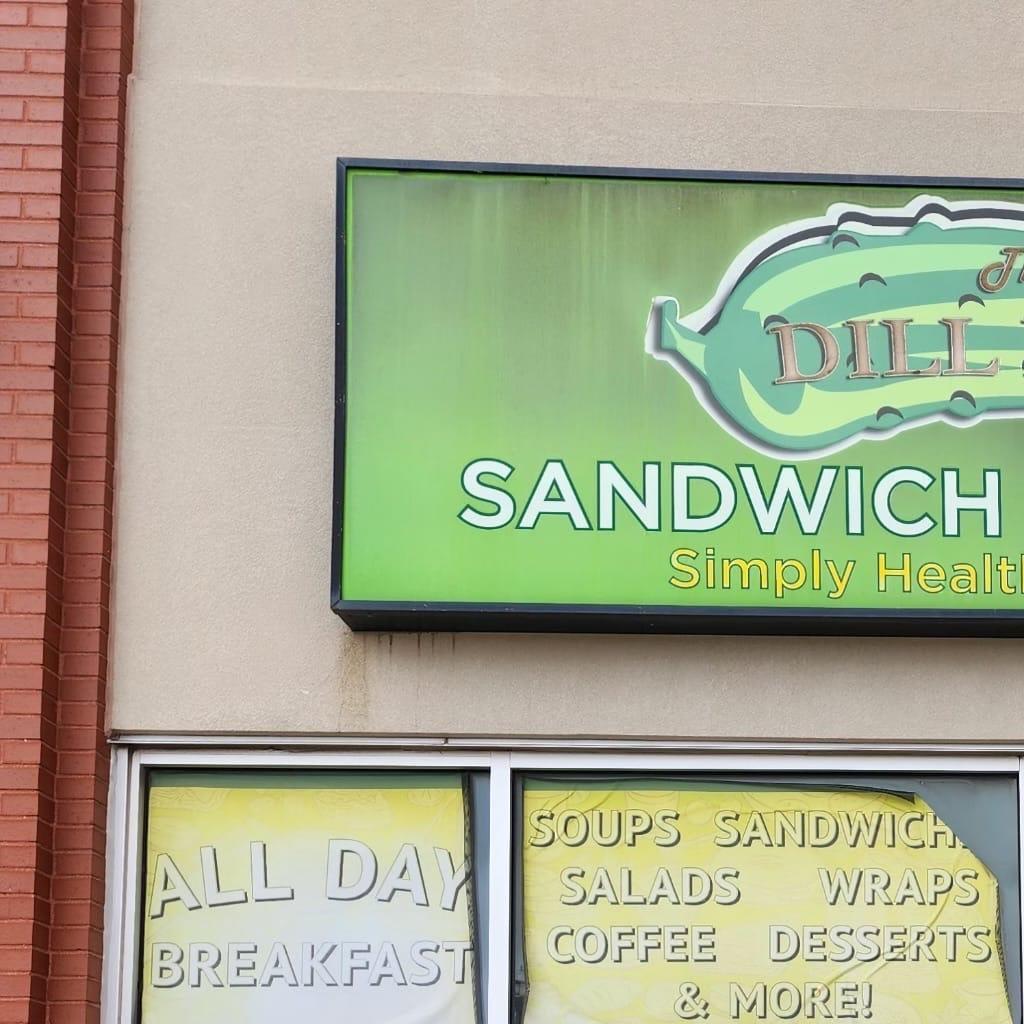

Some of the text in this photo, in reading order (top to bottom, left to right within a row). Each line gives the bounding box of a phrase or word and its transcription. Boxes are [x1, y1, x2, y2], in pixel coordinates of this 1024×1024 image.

[766, 315, 1001, 385] DILL
[458, 457, 1002, 538] SANDWICH
[668, 547, 856, 599] Simply
[528, 808, 968, 849] SOUPS SANDWICH
[148, 838, 472, 919] ALL DAY
[559, 866, 980, 907] SALADS WRAPS
[151, 940, 475, 988] BREAKFAST
[546, 924, 993, 963] COFFEE DESSERTS
[673, 981, 873, 1020] & MORE!
